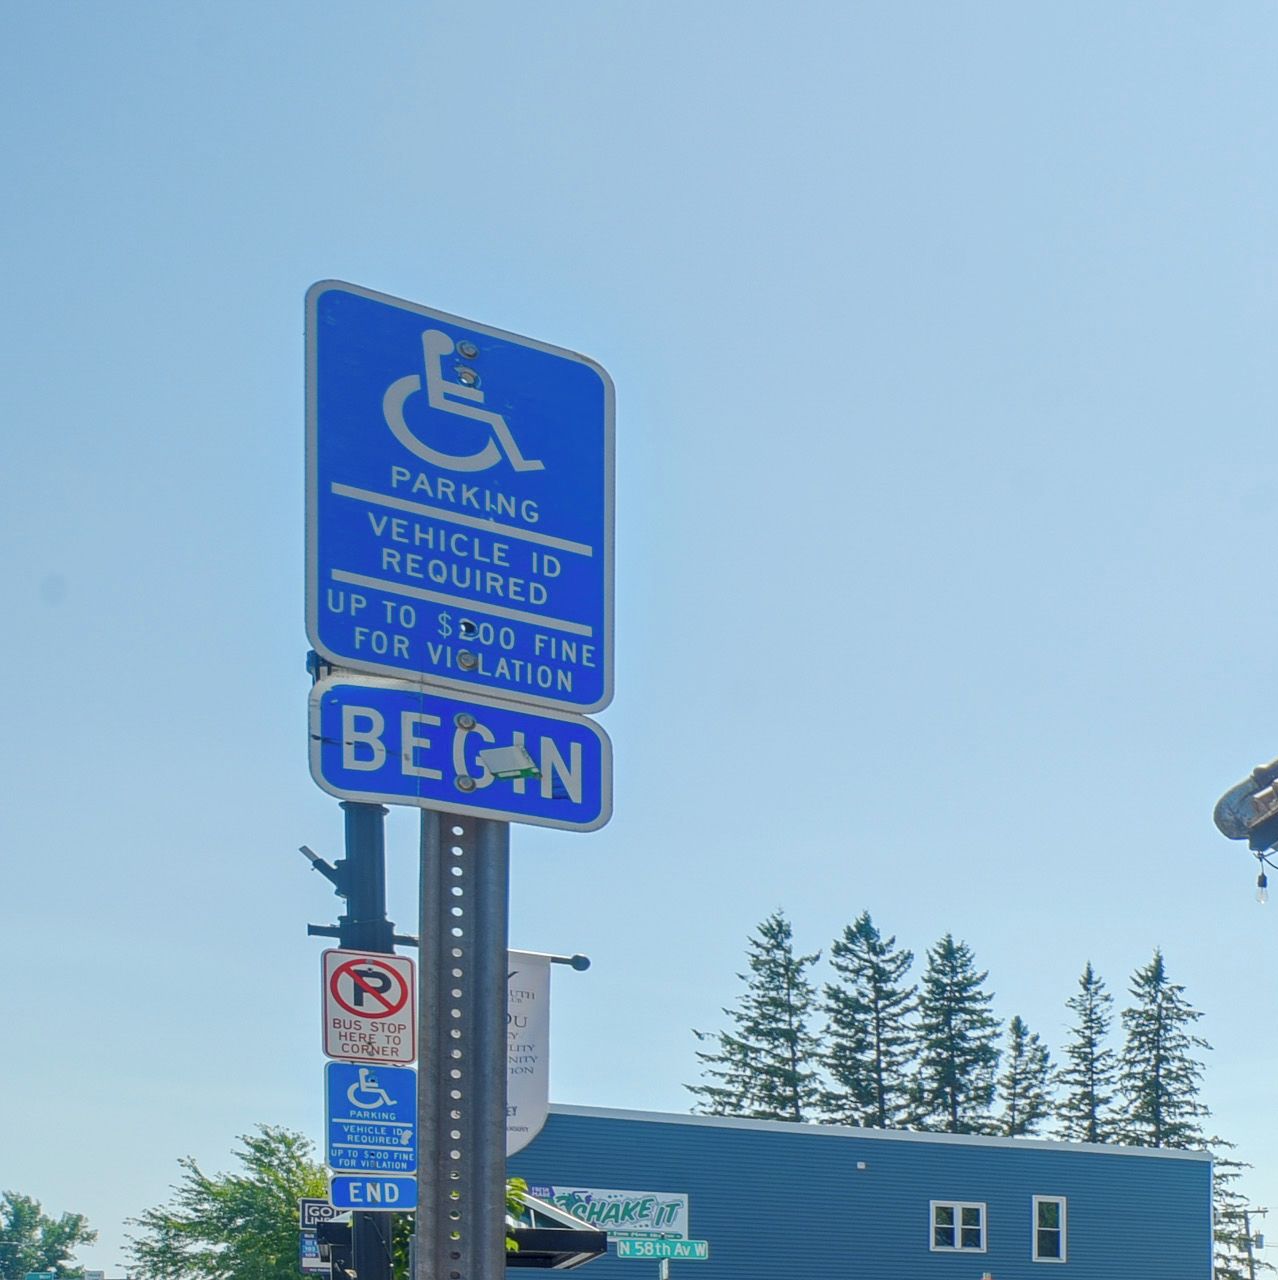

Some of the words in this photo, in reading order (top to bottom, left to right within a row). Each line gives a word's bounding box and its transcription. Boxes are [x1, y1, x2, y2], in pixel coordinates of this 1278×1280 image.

[391, 466, 540, 523] PARKING
[368, 512, 510, 567] VEHICLE
[532, 551, 561, 577] ID
[382, 548, 547, 605] REQUIRED
[327, 588, 367, 616] UP
[382, 600, 416, 628] TO
[534, 634, 596, 667] FINE
[354, 627, 409, 659] FOR
[341, 704, 582, 804] BEGIN
[332, 1018, 362, 1031] BUS
[370, 1021, 406, 1034] STOP
[338, 1031, 377, 1044] HERE
[385, 1035, 402, 1046] TO
[341, 1043, 400, 1057] CORNER
[349, 1110, 396, 1121] PARKING
[343, 1124, 387, 1135] VEHICLE
[392, 1127, 402, 1136] ID
[347, 1135, 399, 1145] REQUIRED
[331, 1149, 344, 1157] UP
[347, 1150, 358, 1159] TO
[393, 1152, 414, 1161] FINE
[339, 1158, 356, 1168] FOR
[349, 1182, 400, 1204] END
[308, 1206, 332, 1217] GO
[571, 1198, 655, 1224] SHAKE
[655, 1202, 682, 1227] IT
[620, 1241, 630, 1256] N
[634, 1243, 671, 1257] 58th
[674, 1244, 690, 1257] Av
[694, 1244, 707, 1257] W
